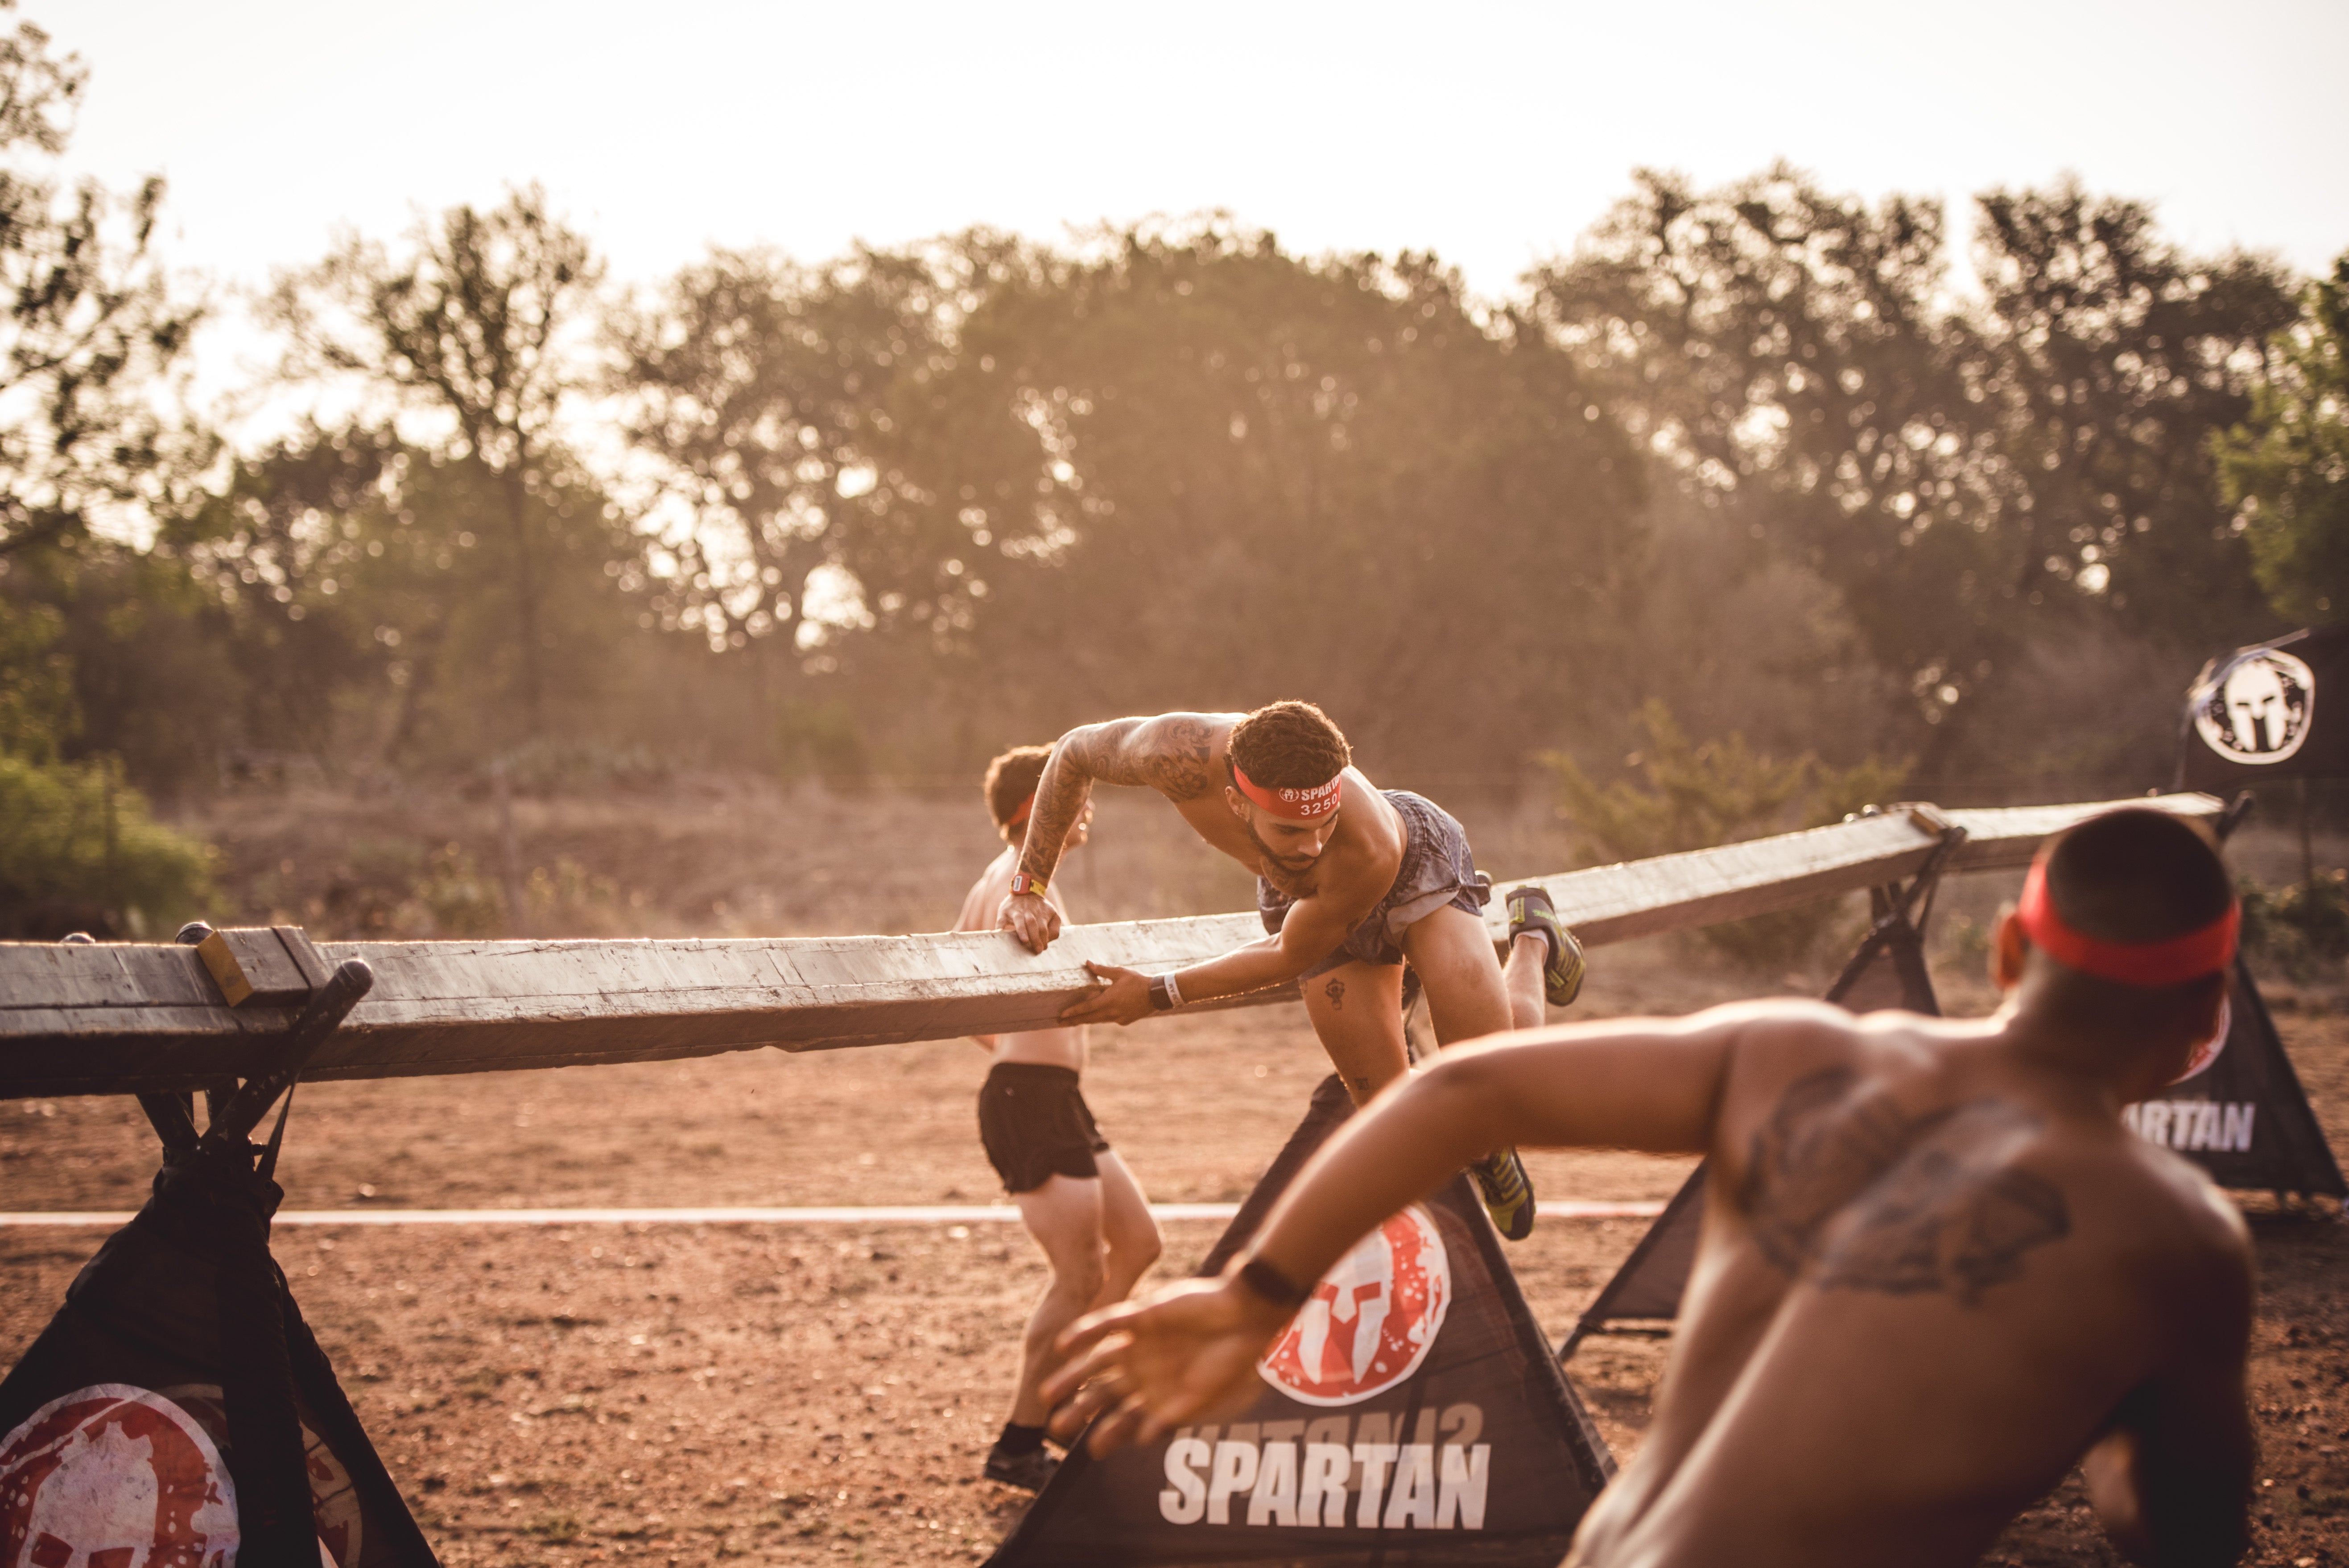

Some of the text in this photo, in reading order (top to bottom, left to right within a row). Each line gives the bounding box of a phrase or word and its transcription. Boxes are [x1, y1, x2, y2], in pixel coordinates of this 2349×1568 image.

[1300, 793, 1337, 816] 3250
[2122, 1101, 2255, 1152] RTAN
[1159, 1438, 1491, 1530] SPARTAN
